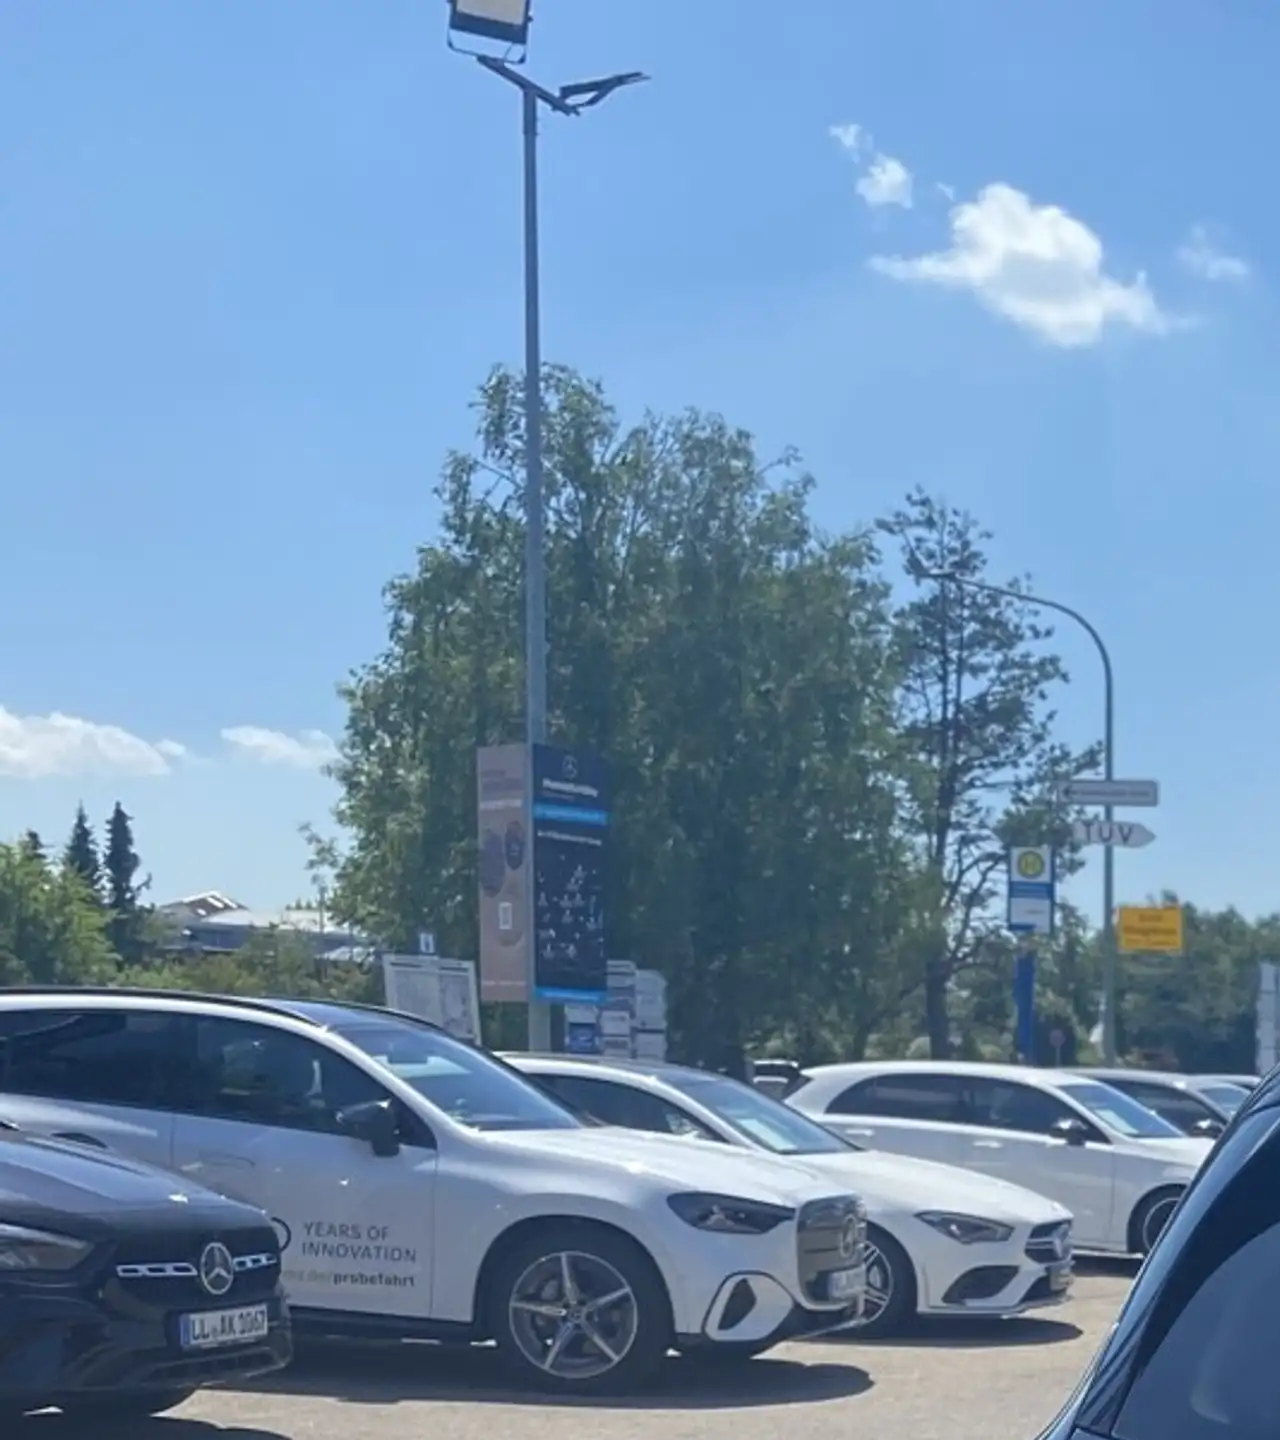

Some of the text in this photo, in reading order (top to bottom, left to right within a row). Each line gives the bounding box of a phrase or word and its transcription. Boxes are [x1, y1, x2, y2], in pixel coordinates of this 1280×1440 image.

[303, 1221, 389, 1241] YEARS OF
[302, 1241, 417, 1263] INNOVATION
